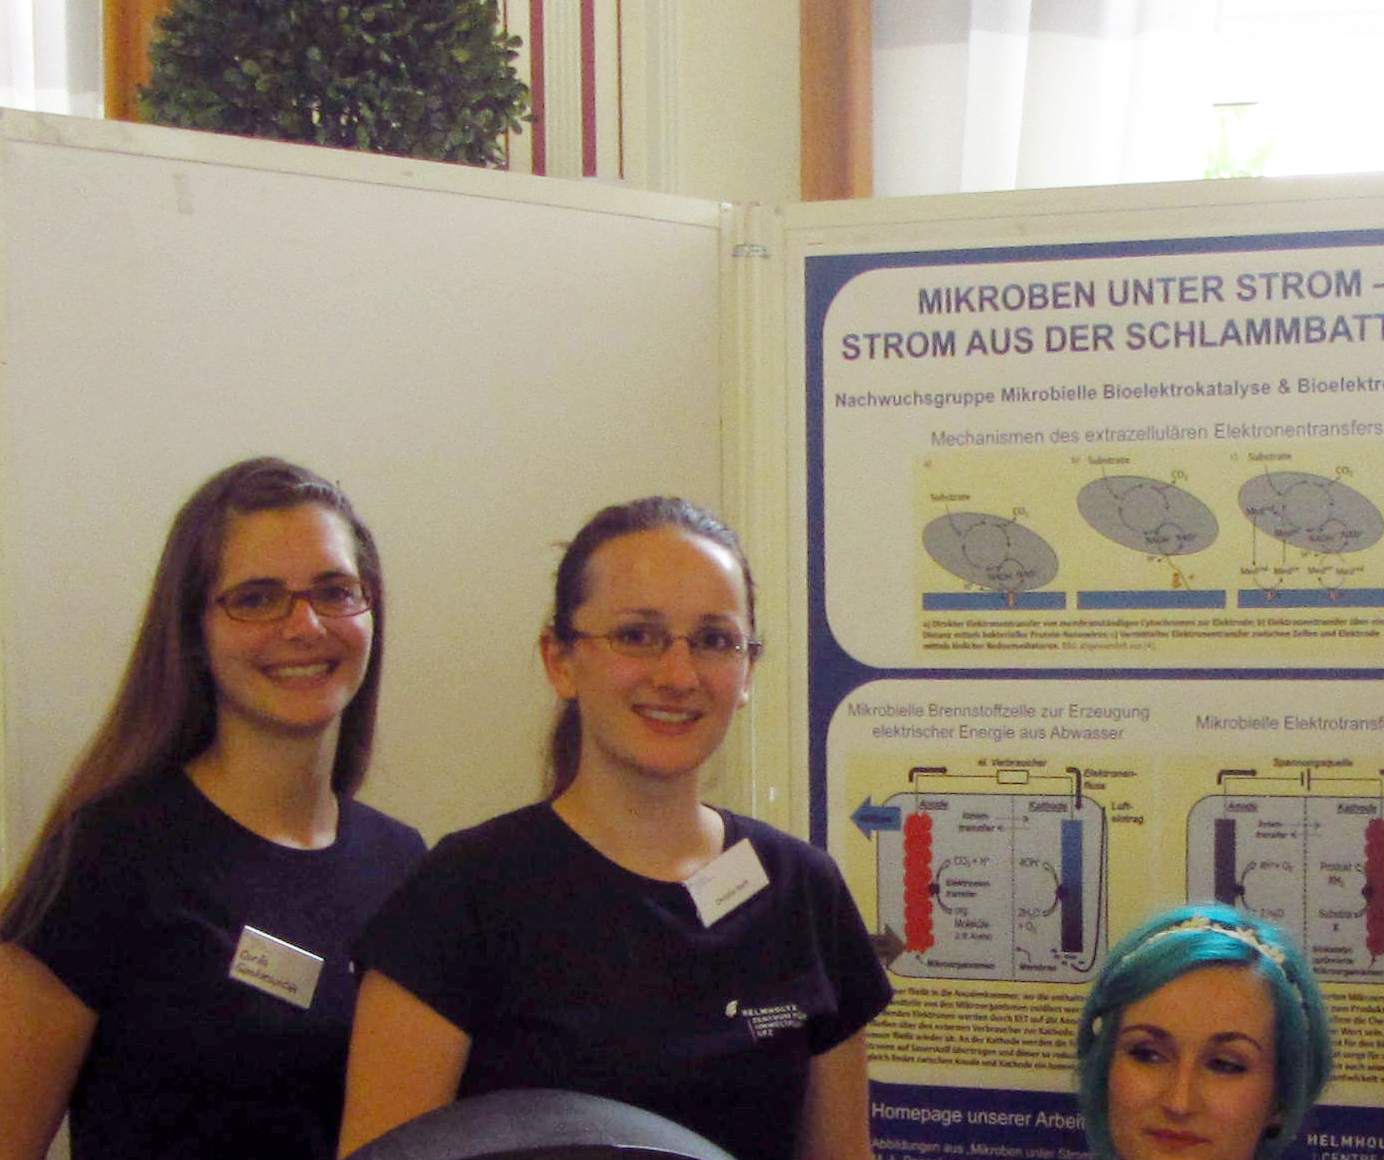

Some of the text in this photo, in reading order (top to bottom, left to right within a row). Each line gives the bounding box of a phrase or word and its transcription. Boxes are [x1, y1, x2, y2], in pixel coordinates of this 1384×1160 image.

[918, 280, 1095, 315] MIKROBEN
[1109, 275, 1224, 307] UNTER
[1236, 269, 1362, 302] STROM
[841, 330, 956, 361] STROM
[966, 326, 1034, 357] AUS
[1046, 323, 1114, 353] DER
[835, 390, 995, 408] Nachwuchsgruppe
[1001, 384, 1097, 402] Mikrobielle
[1103, 380, 1270, 399] Bioelektrokatalyse
[1278, 378, 1291, 394] &
[931, 418, 1384, 447] Mechanismen des extrazellulären Elektronentransfers
[848, 703, 1150, 723] Mikrobielle Brennstoffzelle zur Erzeugung
[1196, 715, 1279, 730] Mikrobielle
[872, 724, 1125, 743] elektrischer Energie aus Abwasser
[871, 1102, 962, 1127] Homepage
[968, 1110, 1030, 1127] unserer
